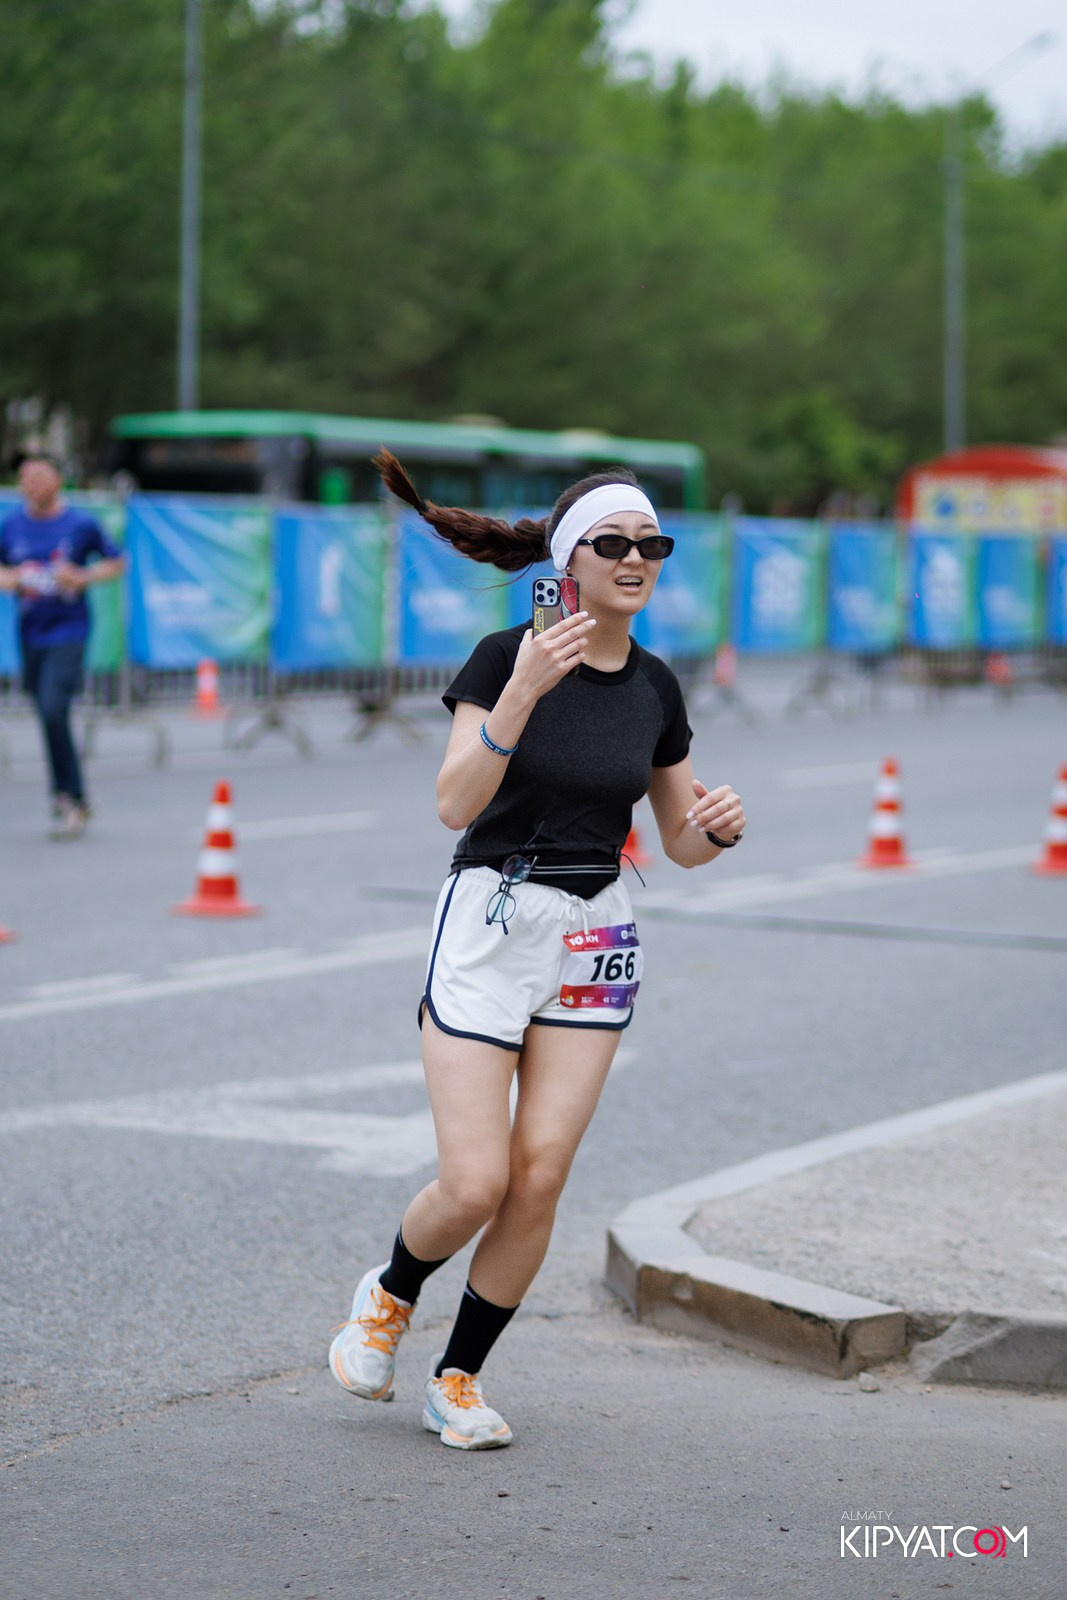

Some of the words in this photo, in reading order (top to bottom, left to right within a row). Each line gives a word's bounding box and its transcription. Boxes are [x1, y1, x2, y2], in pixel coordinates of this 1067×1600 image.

[569, 935, 584, 946] 10
[586, 935, 599, 943] KM
[590, 951, 635, 982] 166
